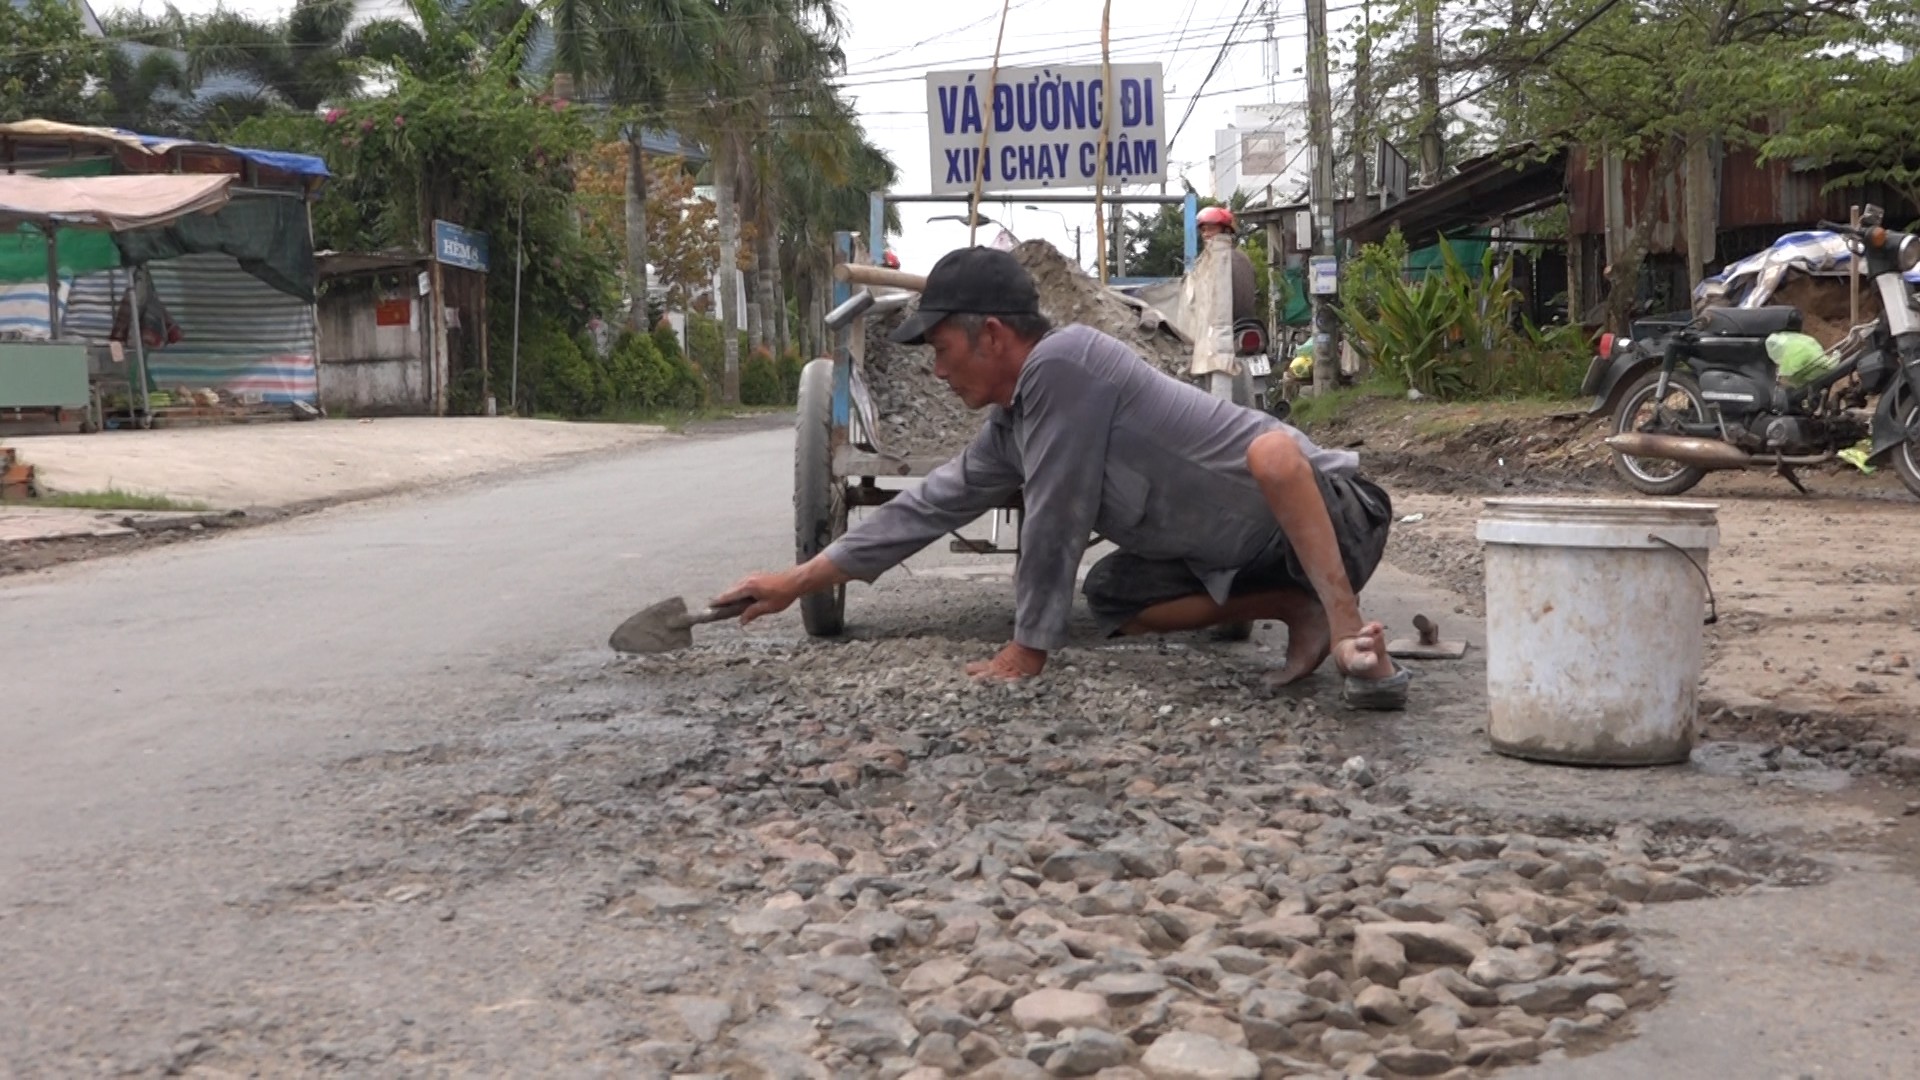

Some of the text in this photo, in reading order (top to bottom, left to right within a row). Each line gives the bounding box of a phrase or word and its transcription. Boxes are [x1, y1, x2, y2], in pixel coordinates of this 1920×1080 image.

[938, 69, 1154, 135] VÁ ĐƯỜNG ĐI
[945, 133, 1158, 186] XIN CHẠY CHẬM
